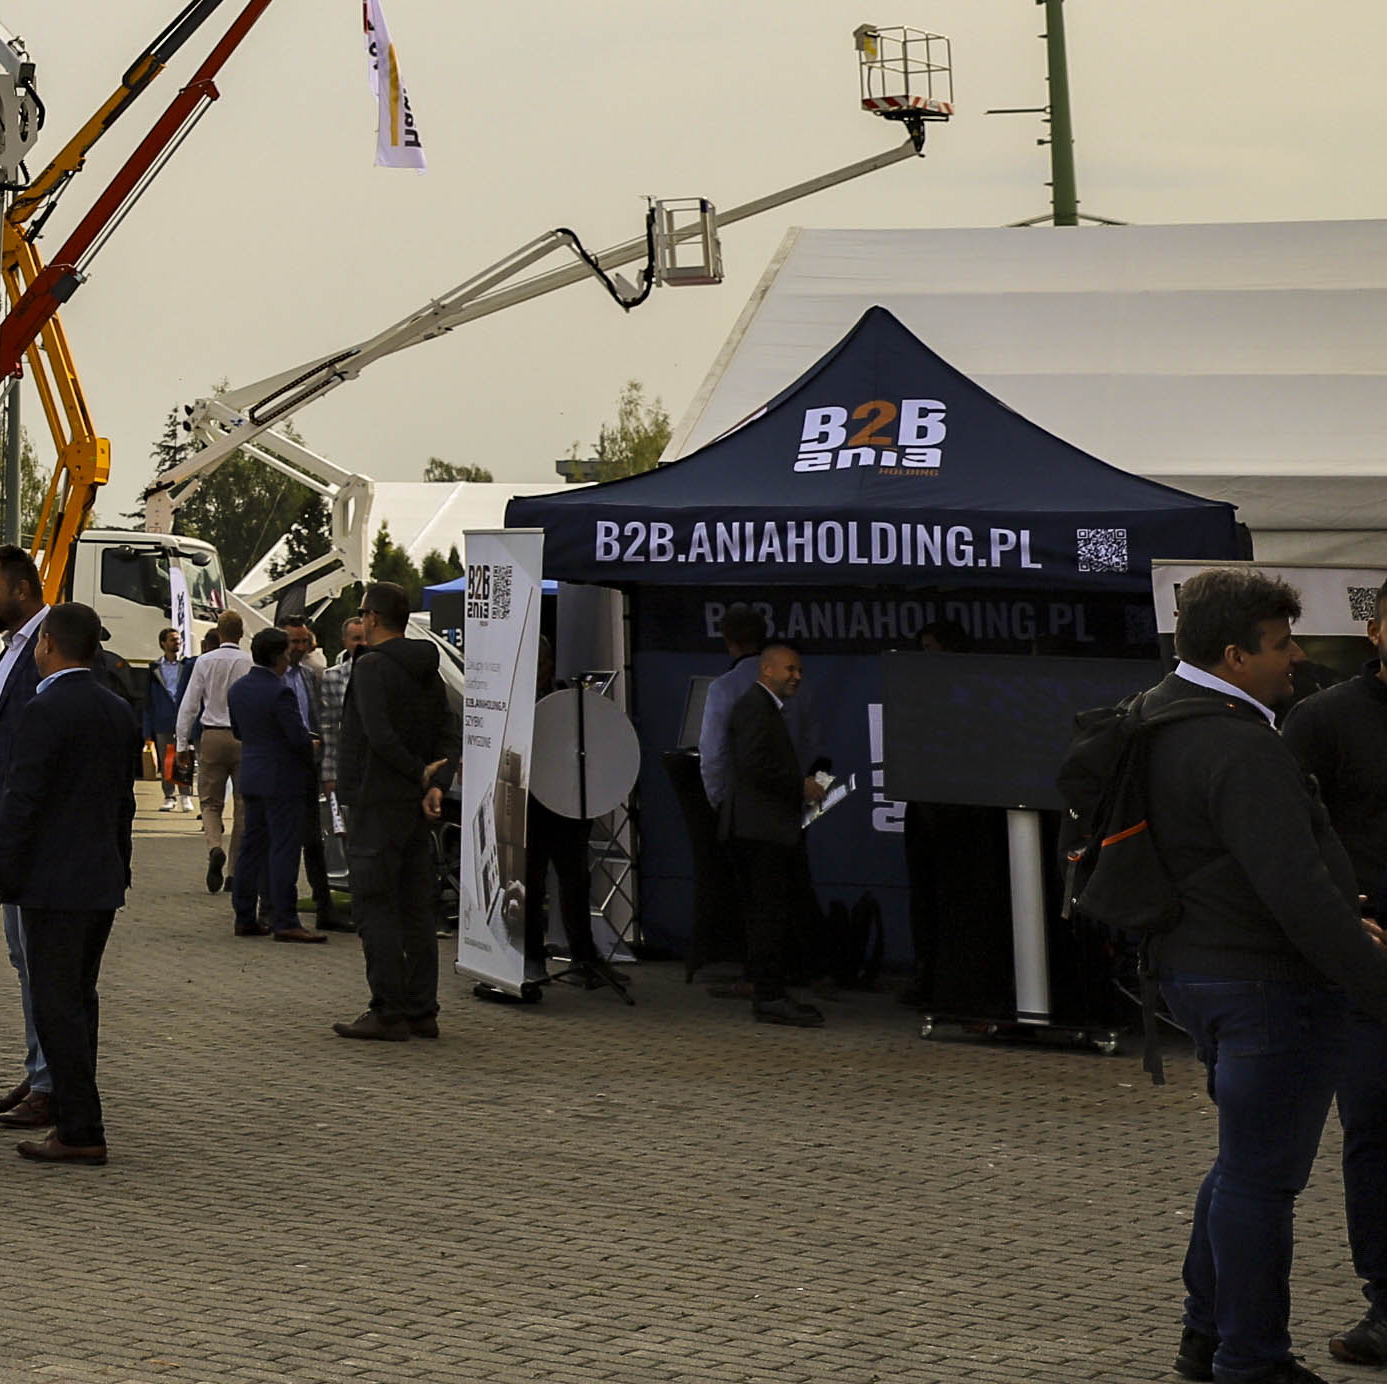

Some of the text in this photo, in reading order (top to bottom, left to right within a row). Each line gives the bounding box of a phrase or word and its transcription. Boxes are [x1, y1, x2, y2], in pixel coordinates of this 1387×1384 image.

[799, 398, 947, 452] B2B
[793, 447, 942, 473] ania
[878, 467, 940, 477] HOLDING
[594, 519, 1043, 570] B2B.ANIAHOLDING.PL
